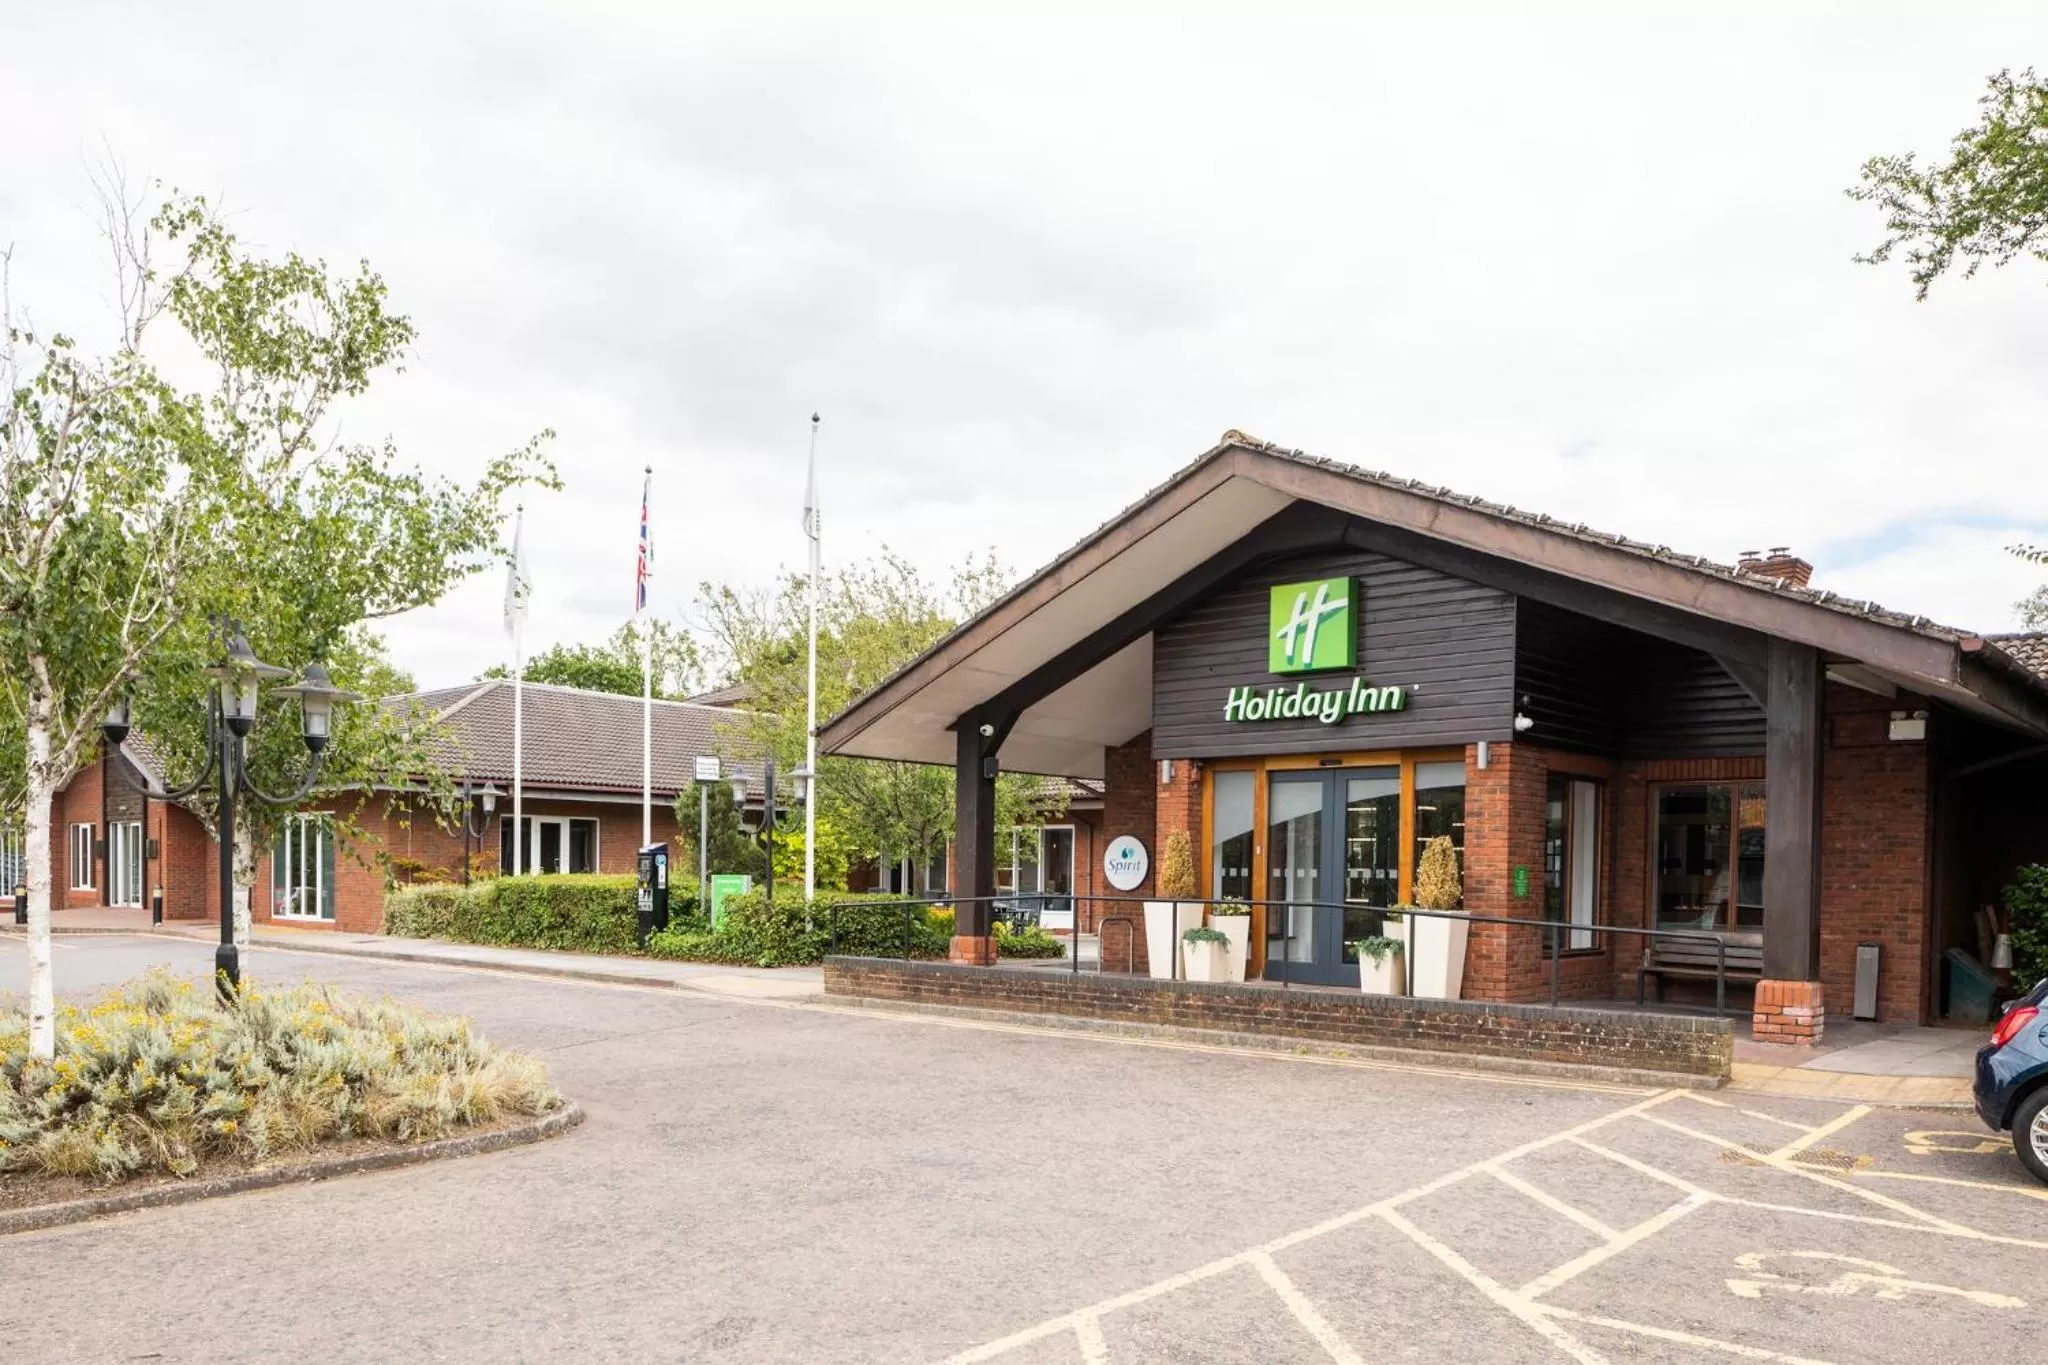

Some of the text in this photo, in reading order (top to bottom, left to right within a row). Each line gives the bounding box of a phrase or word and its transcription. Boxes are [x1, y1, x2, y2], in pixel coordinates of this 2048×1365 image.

[1223, 676, 1402, 724] Holiday Inn
[1109, 860, 1141, 874] Spirit
